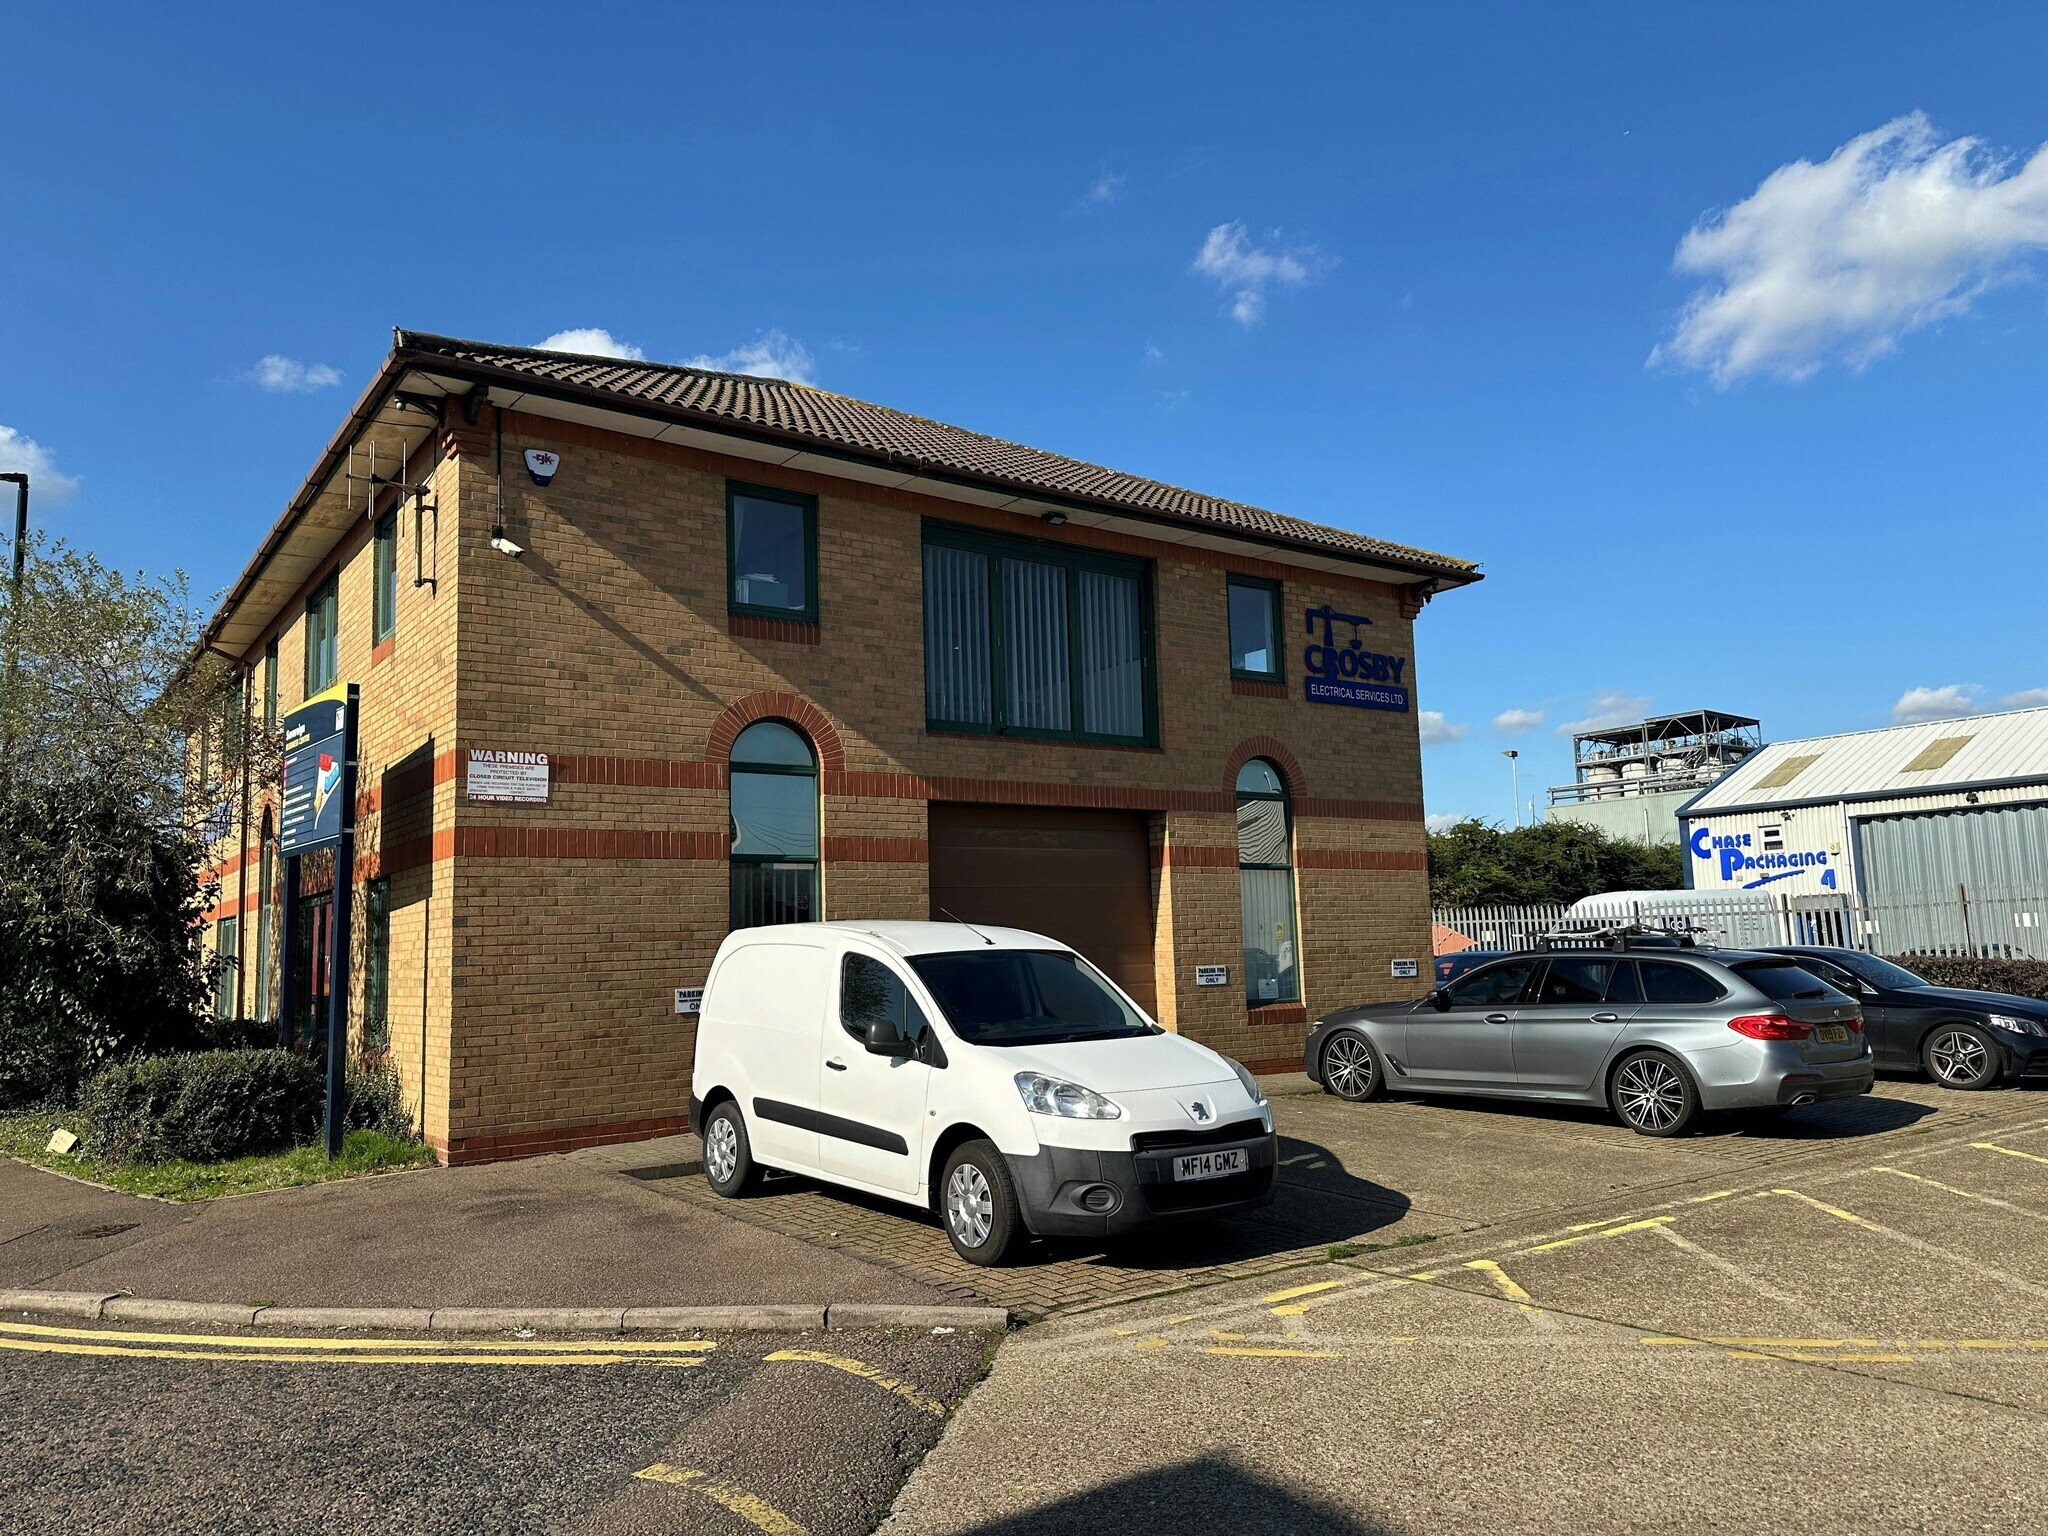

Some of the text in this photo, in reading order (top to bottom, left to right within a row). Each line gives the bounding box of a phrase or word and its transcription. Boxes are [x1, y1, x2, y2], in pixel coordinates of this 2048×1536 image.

[1305, 644, 1406, 683] CROSBY
[1311, 684, 1405, 704] ELECTRICAL SERVICES LTD.
[470, 749, 548, 765] WARNING
[1691, 828, 1751, 859] CHASE
[1720, 848, 1827, 880] PACKAGING
[679, 990, 704, 998] PARKIN
[1182, 1152, 1239, 1176] MF14 GMZ
